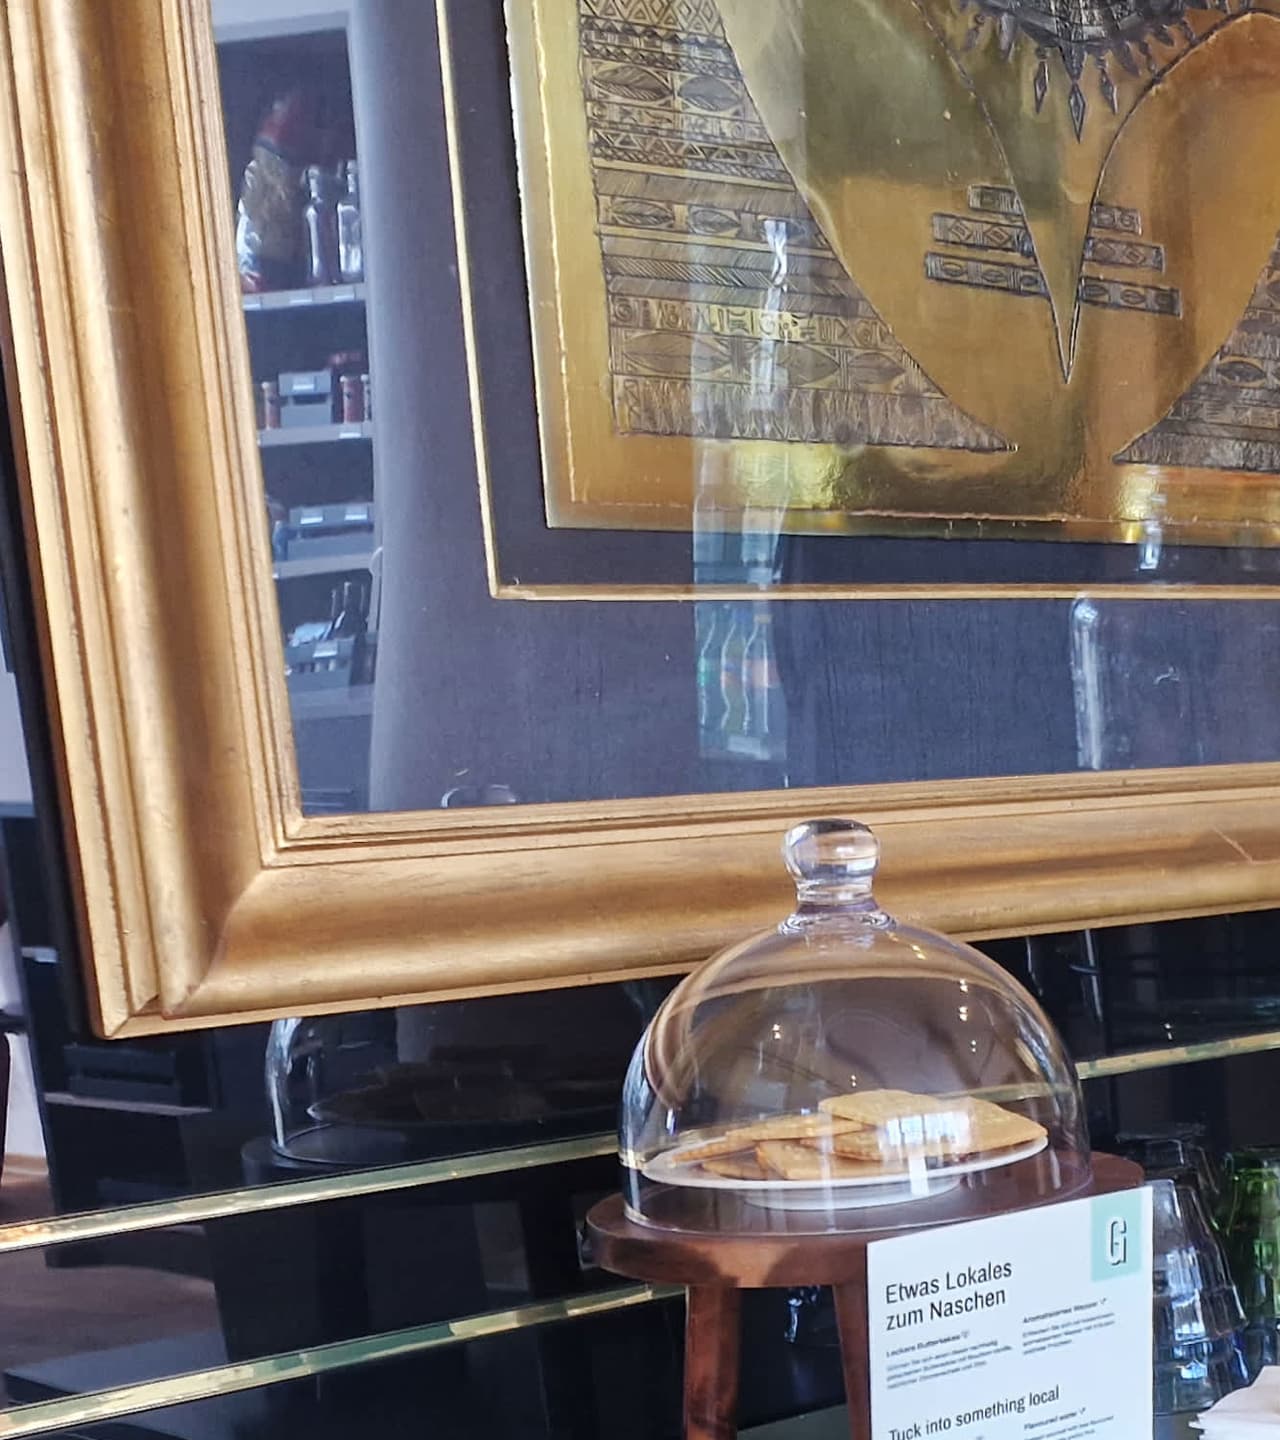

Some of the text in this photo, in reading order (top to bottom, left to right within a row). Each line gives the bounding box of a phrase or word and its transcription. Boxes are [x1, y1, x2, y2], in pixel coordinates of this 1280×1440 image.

[1109, 1217, 1127, 1266] G
[886, 1262, 1011, 1304] Etwas Lokales
[887, 1290, 1005, 1330] zum Naschen
[926, 1418, 951, 1434] into
[956, 1398, 1025, 1426] something
[1029, 1384, 1059, 1406] local
